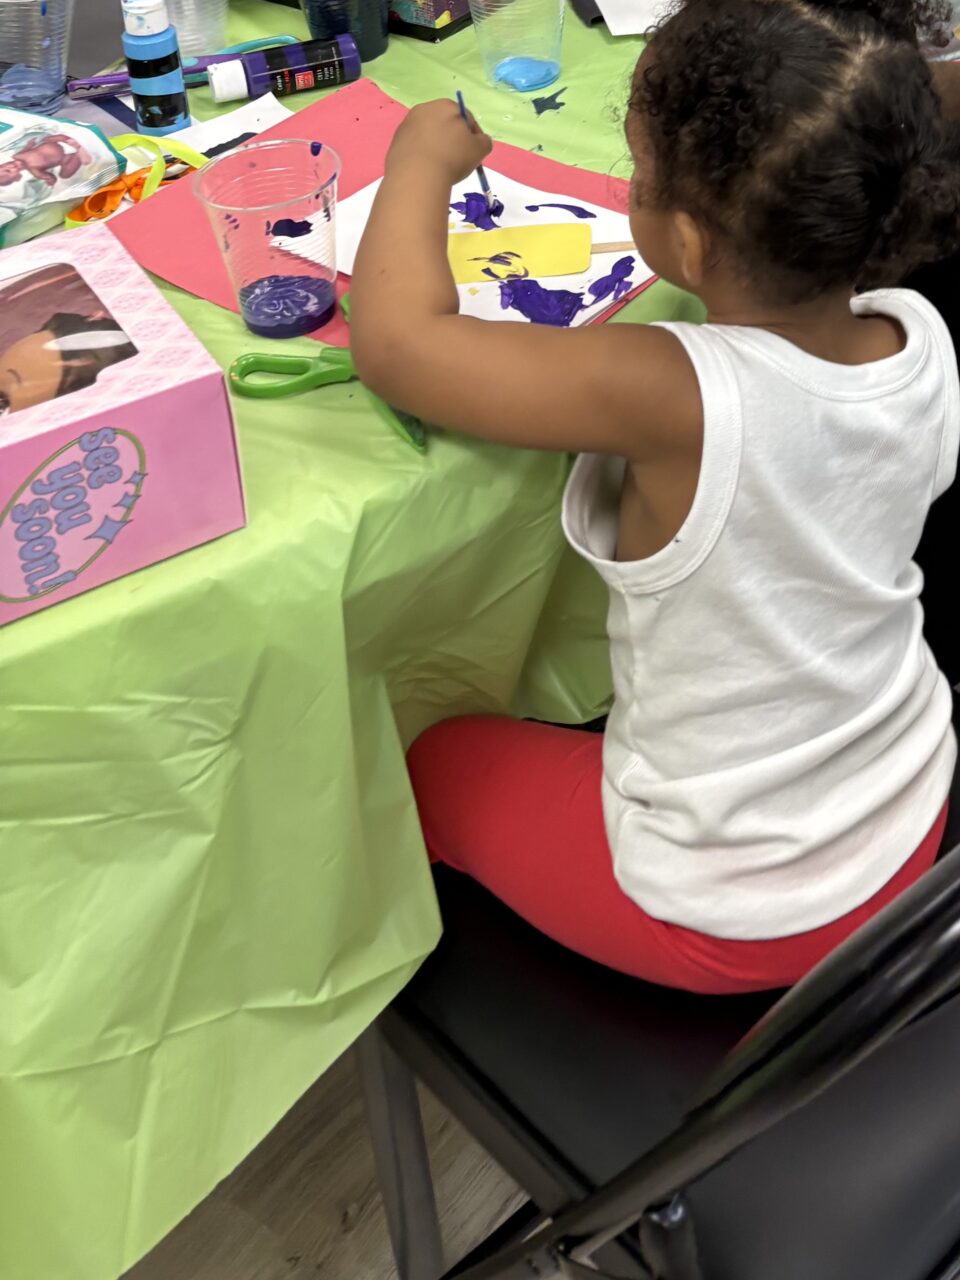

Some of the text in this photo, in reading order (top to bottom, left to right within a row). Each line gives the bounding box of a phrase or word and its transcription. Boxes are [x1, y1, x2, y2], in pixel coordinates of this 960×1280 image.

[79, 427, 123, 490] see
[31, 461, 93, 537] you
[10, 499, 77, 596] soon!
